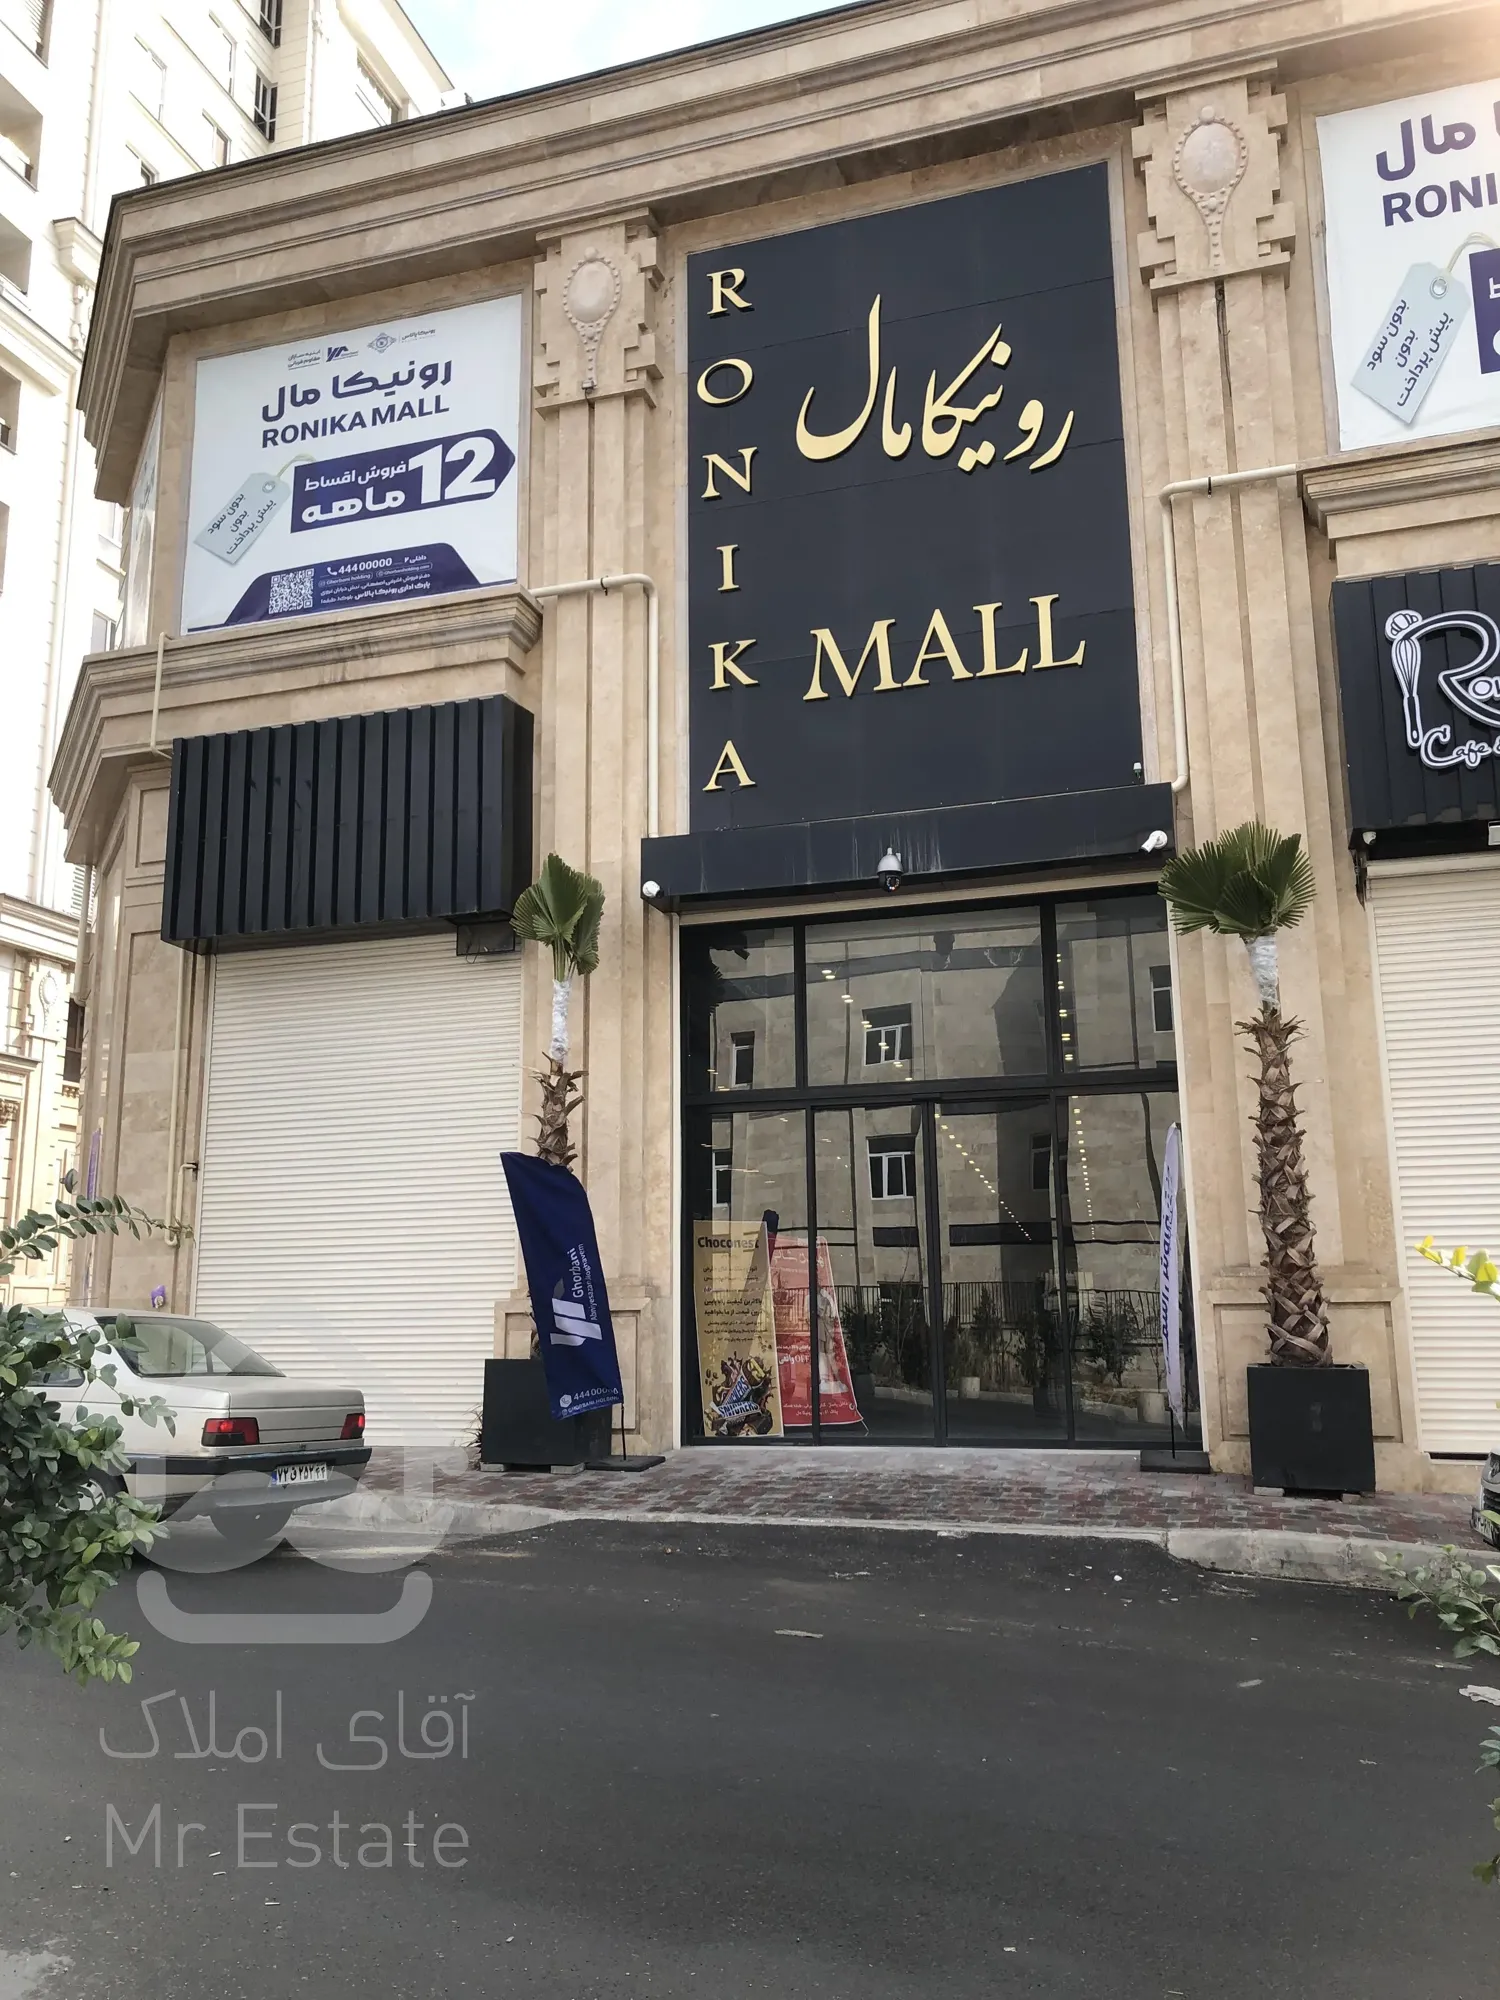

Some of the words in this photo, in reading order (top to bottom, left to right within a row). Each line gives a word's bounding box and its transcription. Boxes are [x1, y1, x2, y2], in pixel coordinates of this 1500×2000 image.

[1376, 113, 1476, 181] مال
[1388, 299, 1409, 337] بدون
[1429, 312, 1454, 353] پیش
[1367, 336, 1388, 370] سود
[1395, 329, 1418, 368] بدون
[332, 360, 452, 399] رونیکا
[795, 293, 913, 460] مال
[1397, 351, 1434, 406] پرداخت
[262, 384, 321, 423] مال
[262, 410, 367, 448] RONIKA
[371, 394, 450, 427] MALL
[304, 470, 356, 491] اقساط
[357, 461, 407, 485] فروش
[408, 436, 496, 505] 12
[207, 514, 227, 534] سود
[227, 493, 246, 516] بدون
[230, 510, 249, 533] بدون
[256, 499, 277, 524] پیش
[301, 486, 406, 524] ماهه
[226, 522, 259, 555] پرداخت
[696, 267, 759, 792] RONIKA
[338, 557, 393, 575] 44400000
[802, 593, 1087, 702] MALL
[567, 1247, 584, 1298] Ghorbani
